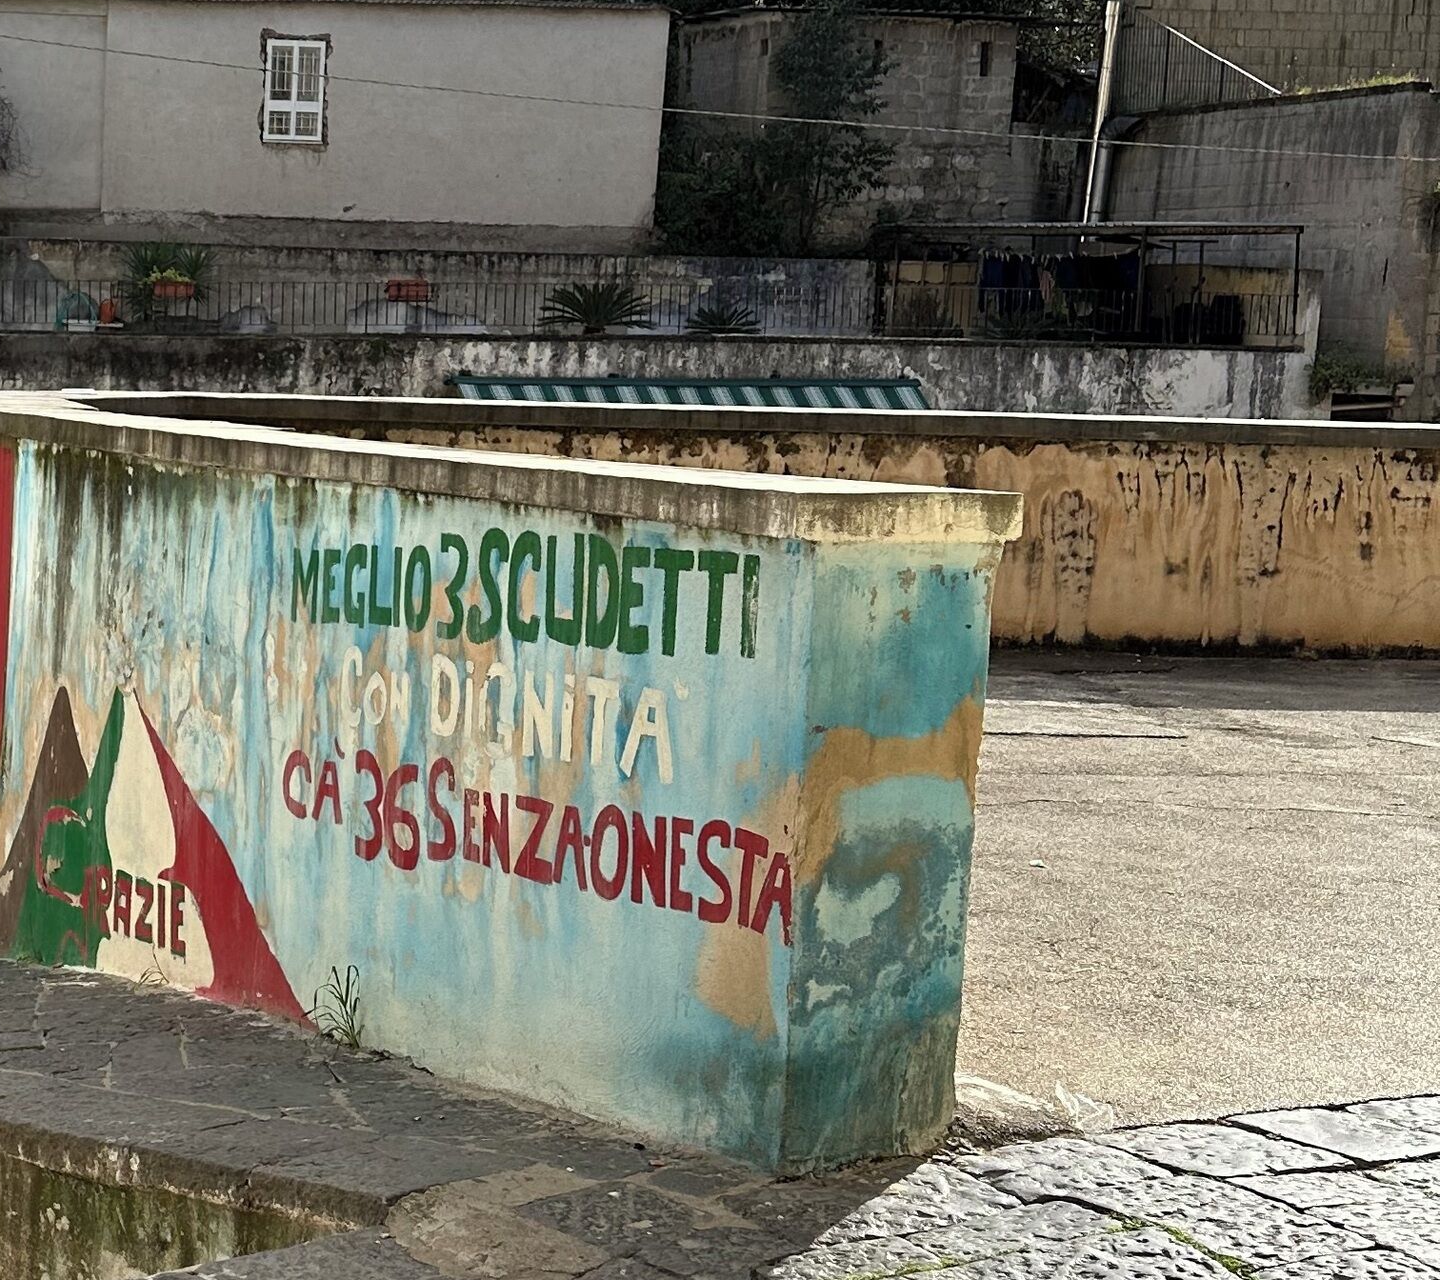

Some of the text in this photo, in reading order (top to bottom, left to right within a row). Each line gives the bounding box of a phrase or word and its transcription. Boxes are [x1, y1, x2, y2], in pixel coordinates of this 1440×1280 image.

[292, 527, 760, 658] MEGLIO 3 SCUDETTI
[355, 748, 419, 871] 36
[36, 806, 187, 957] GRAZIE
